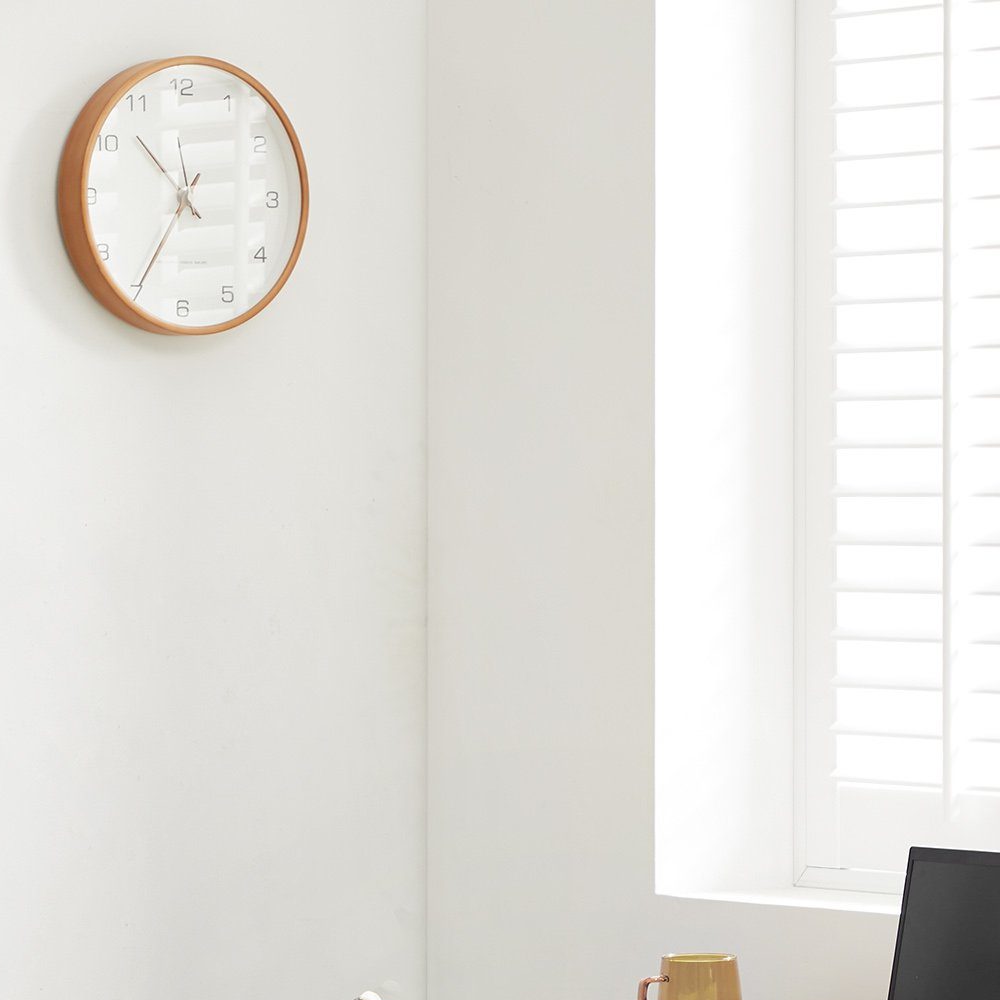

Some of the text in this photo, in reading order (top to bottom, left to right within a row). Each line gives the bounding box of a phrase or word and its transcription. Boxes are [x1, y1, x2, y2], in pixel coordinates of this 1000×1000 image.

[169, 78, 194, 97] 12
[126, 94, 147, 113] 11
[223, 94, 232, 112] 1
[97, 134, 119, 152] 10
[253, 135, 267, 154] 2
[87, 187, 97, 205] 9
[265, 191, 279, 209] 3
[254, 246, 267, 263] 4
[130, 284, 144, 301] 7
[221, 286, 234, 303] 5
[176, 299, 189, 317] 6
